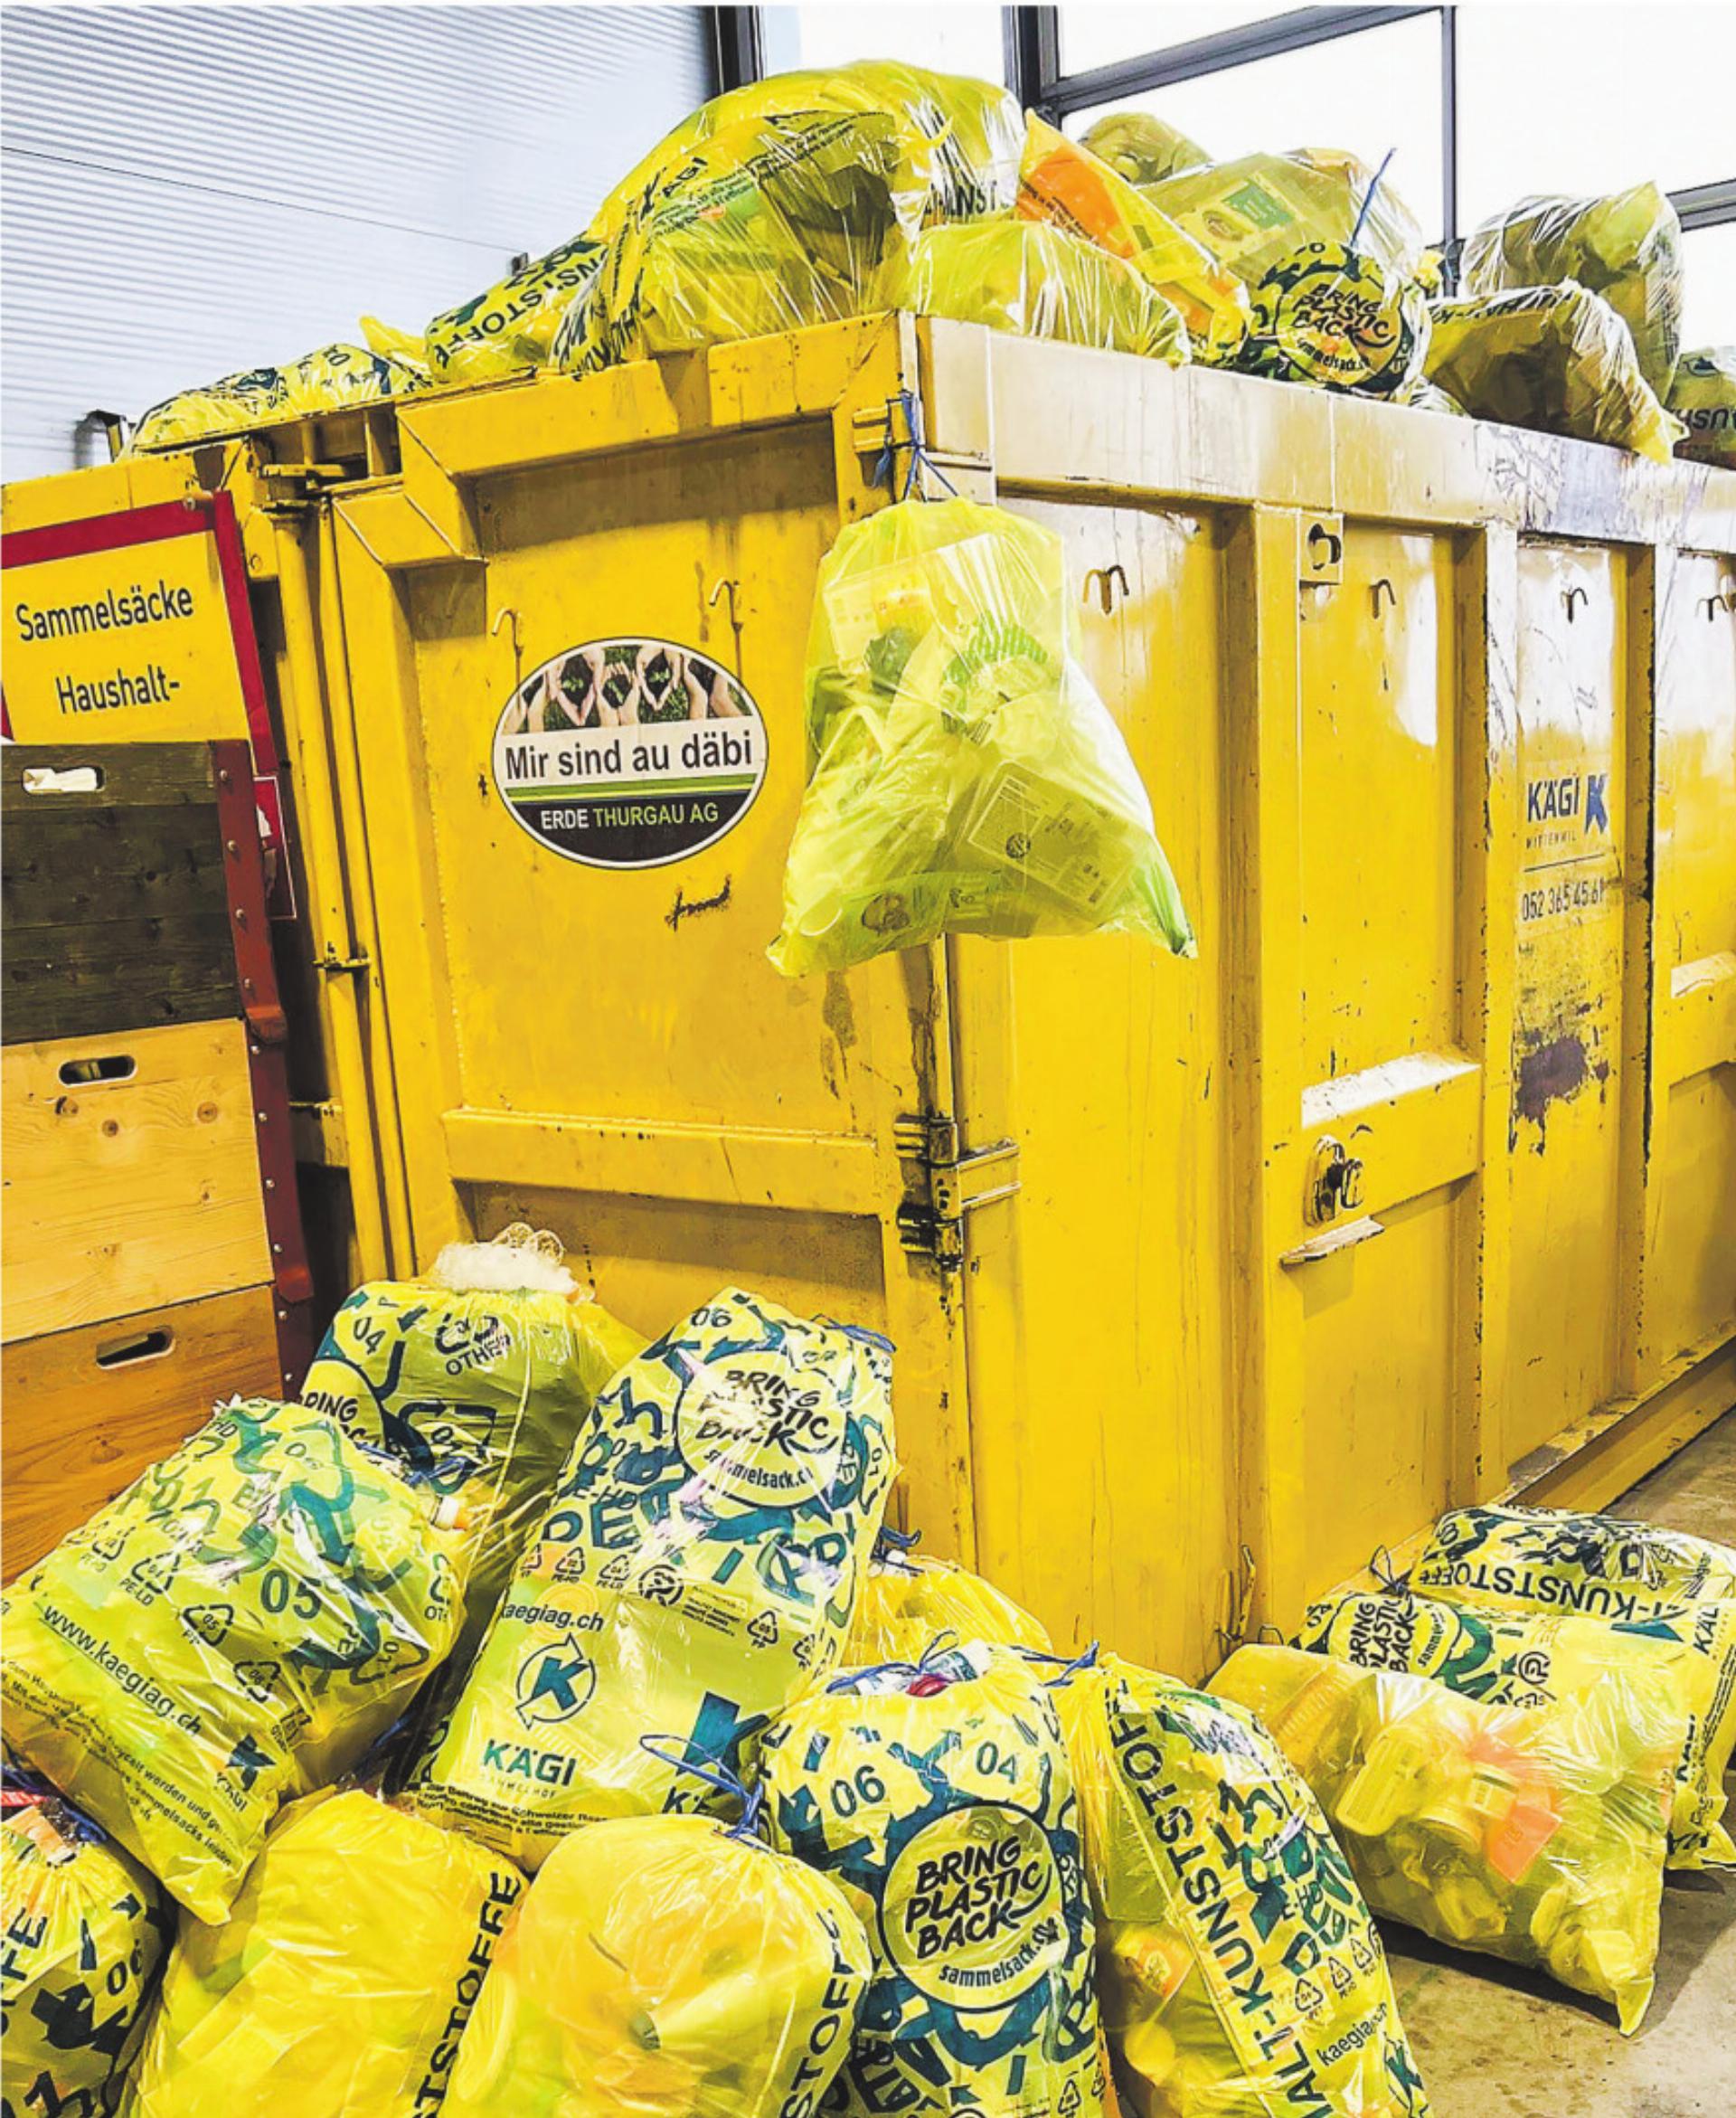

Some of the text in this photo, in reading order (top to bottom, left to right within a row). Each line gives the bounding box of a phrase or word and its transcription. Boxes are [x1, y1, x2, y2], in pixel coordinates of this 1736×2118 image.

[1293, 294, 1389, 338] PLASTIC
[1311, 283, 1382, 313] BRING
[1292, 310, 1382, 347] BACK
[15, 579, 193, 641] Sammelsäcke
[55, 664, 180, 714] Haushalt-
[505, 730, 753, 780] Mir sind au däbi
[541, 802, 719, 830] ERDE THURGAU AG
[1527, 777, 1580, 822] KÄGI
[1522, 892, 1545, 922] 052
[1547, 881, 1571, 916] 365
[1573, 879, 1590, 910] 45
[353, 1317, 386, 1355] 04
[690, 1308, 732, 1328] 06
[724, 1370, 821, 1407] BRING
[260, 1569, 322, 1620] 05
[1390, 1606, 1418, 1672] BACK
[42, 1605, 203, 1734] www.kaegiag.ch
[482, 1738, 578, 1787] KÄGI
[976, 1742, 1020, 1783] 04
[187, 1798, 212, 1820] und
[830, 1764, 886, 1819] 06
[915, 1835, 1021, 1896] BRING
[904, 1860, 1043, 1934] PLASTIC
[917, 1897, 1029, 1960] BACK
